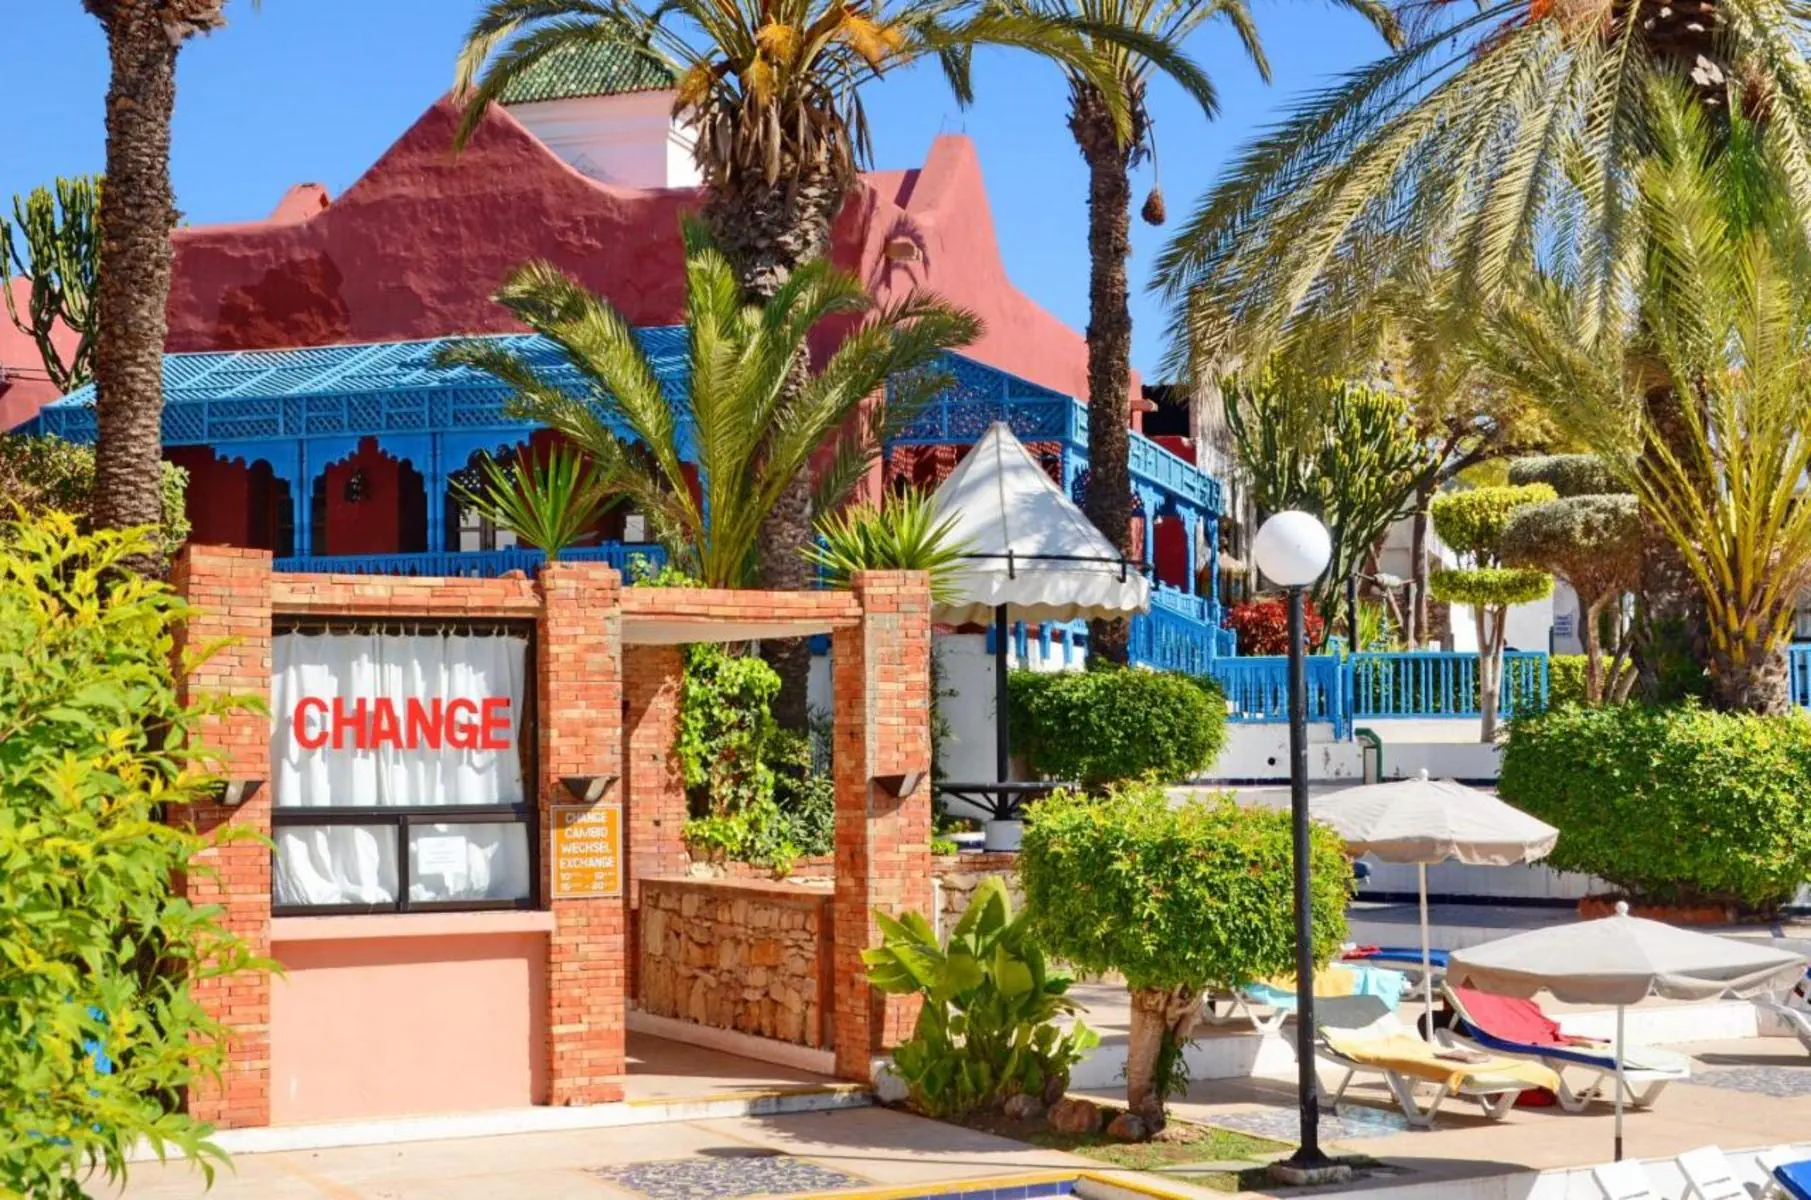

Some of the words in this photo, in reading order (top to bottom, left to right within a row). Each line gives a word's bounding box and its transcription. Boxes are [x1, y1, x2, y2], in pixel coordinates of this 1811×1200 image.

[293, 697, 511, 750] CHANGE
[565, 811, 608, 824] CHANGE
[565, 827, 608, 839] CAMBIO
[560, 842, 612, 854] WECHSEL
[560, 856, 615, 869] EXCHANGE
